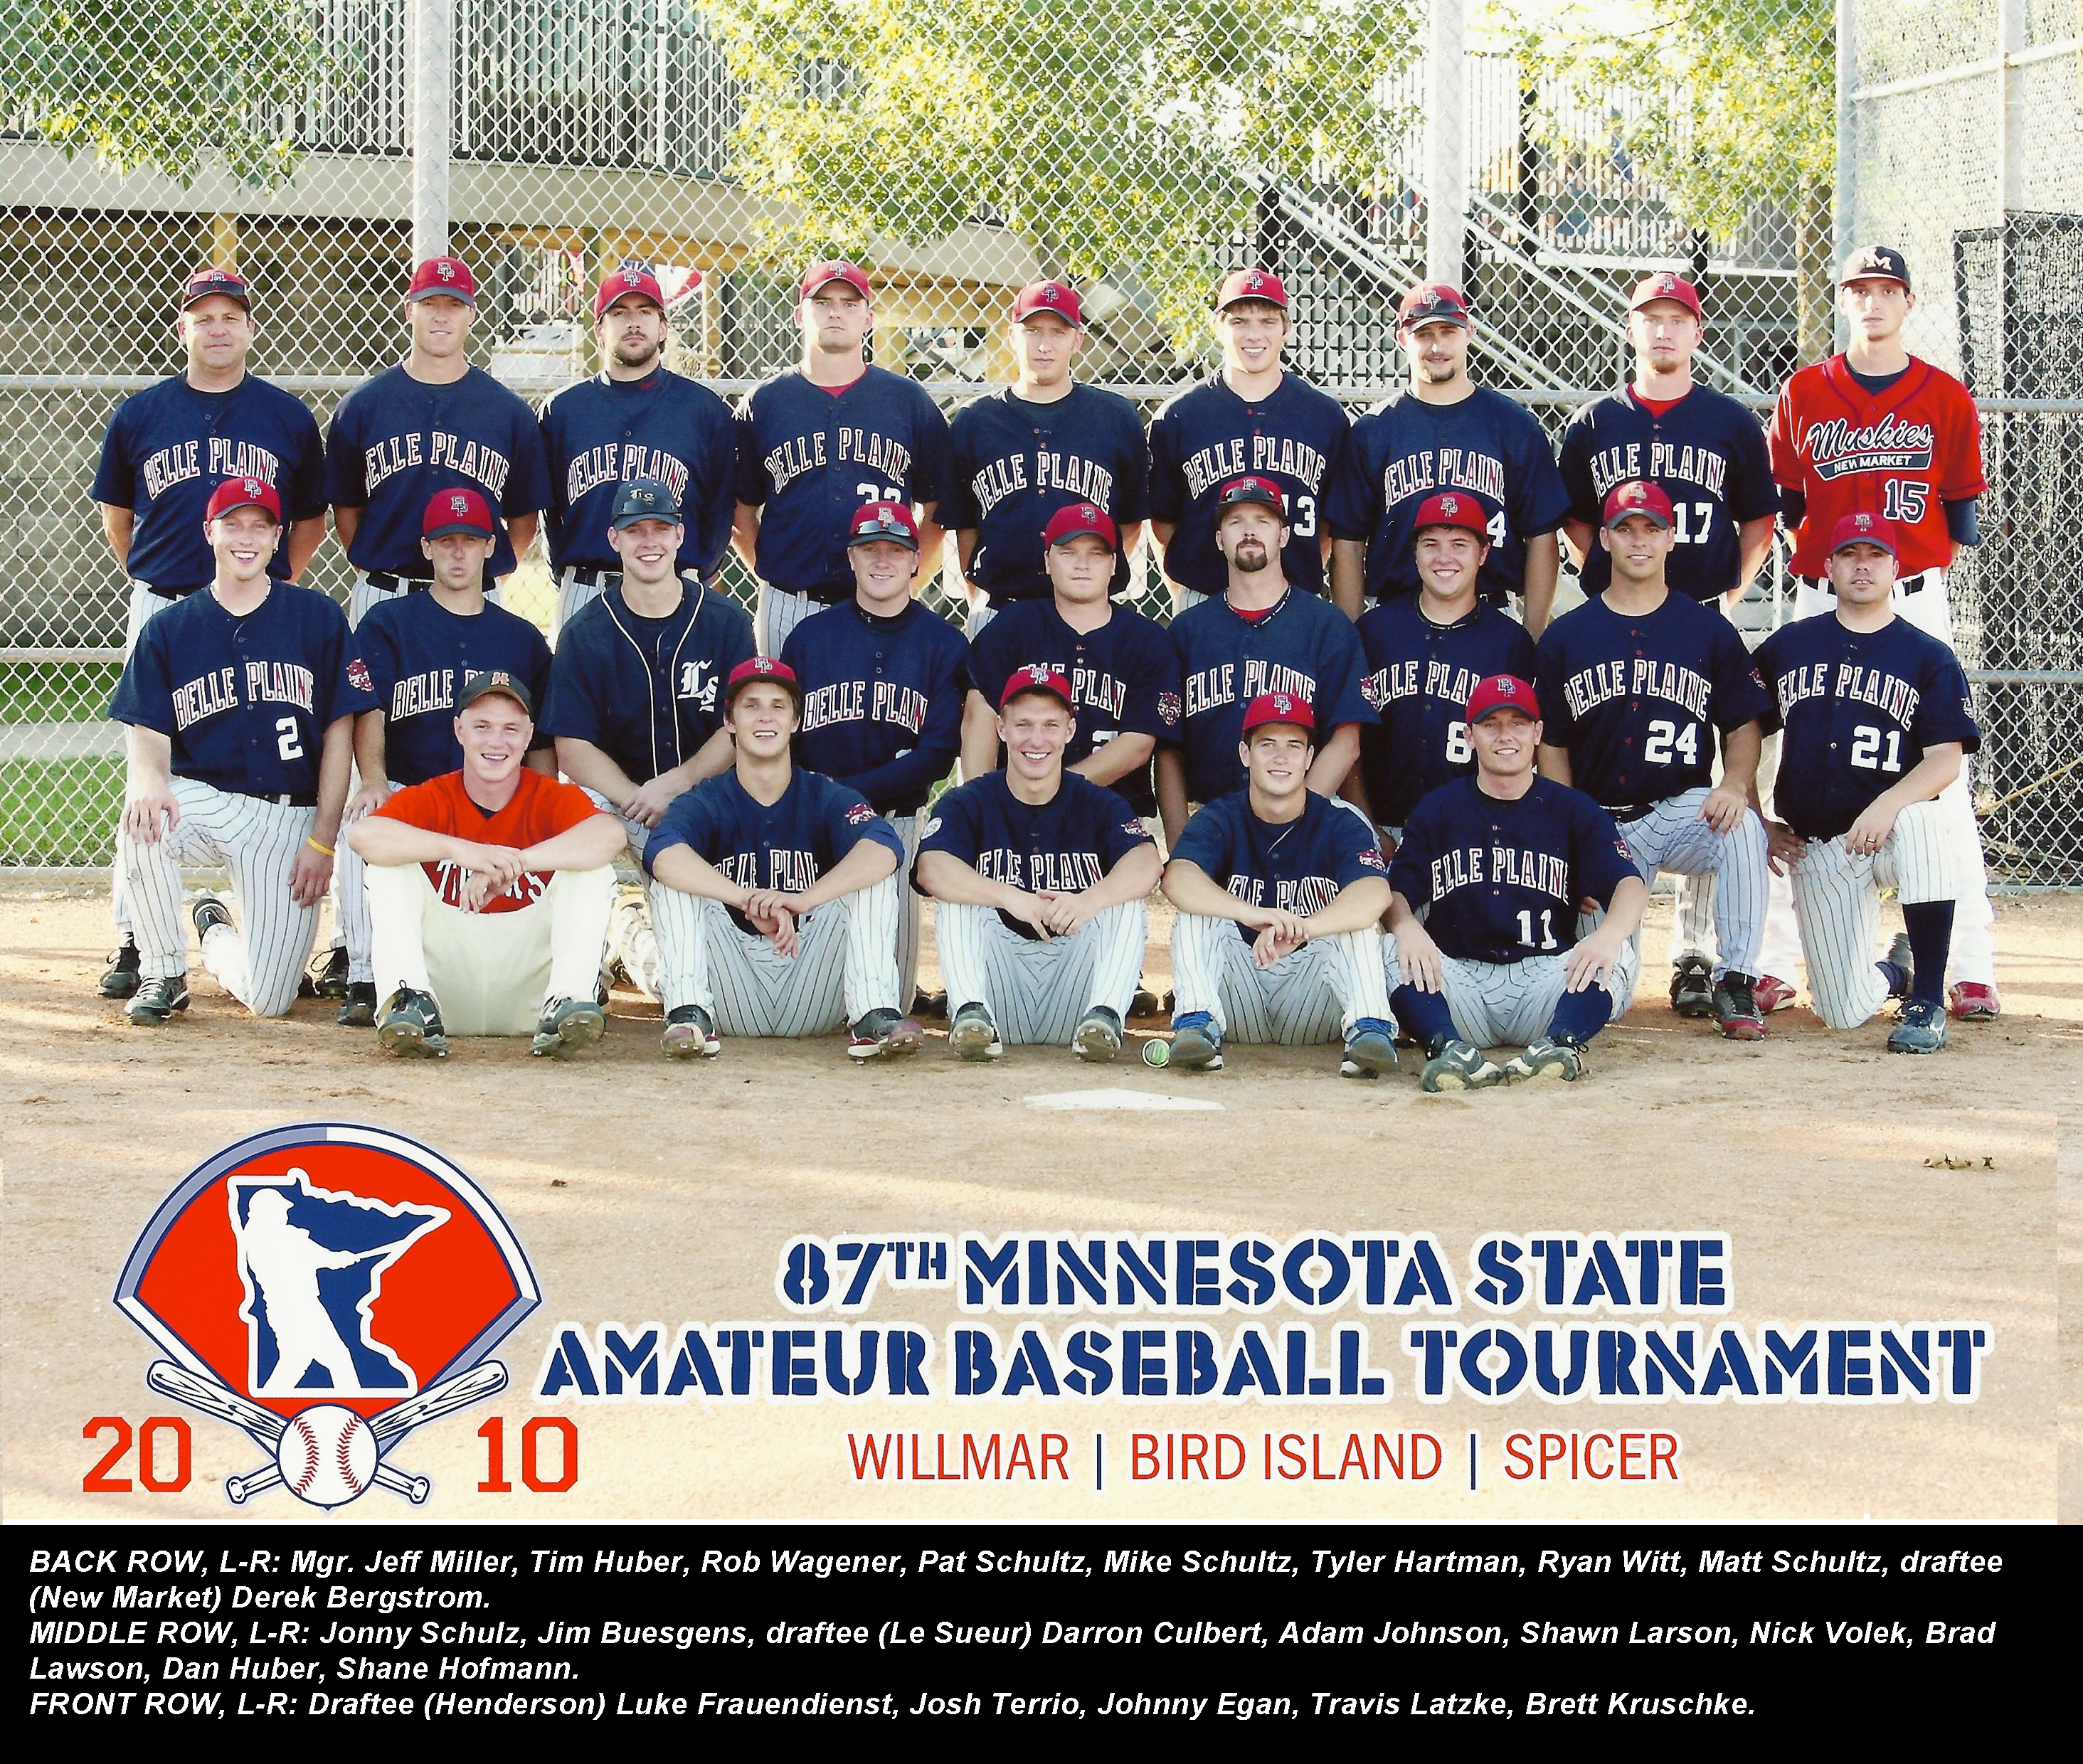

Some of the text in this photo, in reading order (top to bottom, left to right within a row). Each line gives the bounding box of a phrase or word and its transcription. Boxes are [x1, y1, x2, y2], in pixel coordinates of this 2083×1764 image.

[763, 426, 912, 495] BELLE PLAINE
[1801, 413, 1934, 462] Muskies
[1858, 454, 1914, 469] MARKET
[144, 437, 279, 501] BELLE PLAINE
[364, 430, 511, 503] ELLE PLAINE
[1036, 450, 1114, 516] PLAINE
[1182, 435, 1327, 501] BELLE PLAINE
[1589, 442, 1641, 505] ELLE
[1673, 501, 1714, 544] 17
[1883, 478, 1929, 525] 15
[171, 660, 314, 733] BELLE PLAINE
[391, 669, 455, 722] BELLE
[490, 671, 510, 687] H
[1185, 663, 1235, 718] ELLE
[1371, 660, 1419, 713] ELLE
[1631, 659, 1712, 723] PLAINE
[1777, 662, 1920, 733] ELLE PLAINE
[802, 680, 866, 733] BELLE
[275, 715, 304, 761] 2
[1643, 719, 1698, 765] 24
[1850, 724, 1902, 773] 21
[1030, 852, 1103, 891] PLAIN
[1431, 846, 1569, 906] ELLE PLAIN
[1516, 908, 1557, 950] 11
